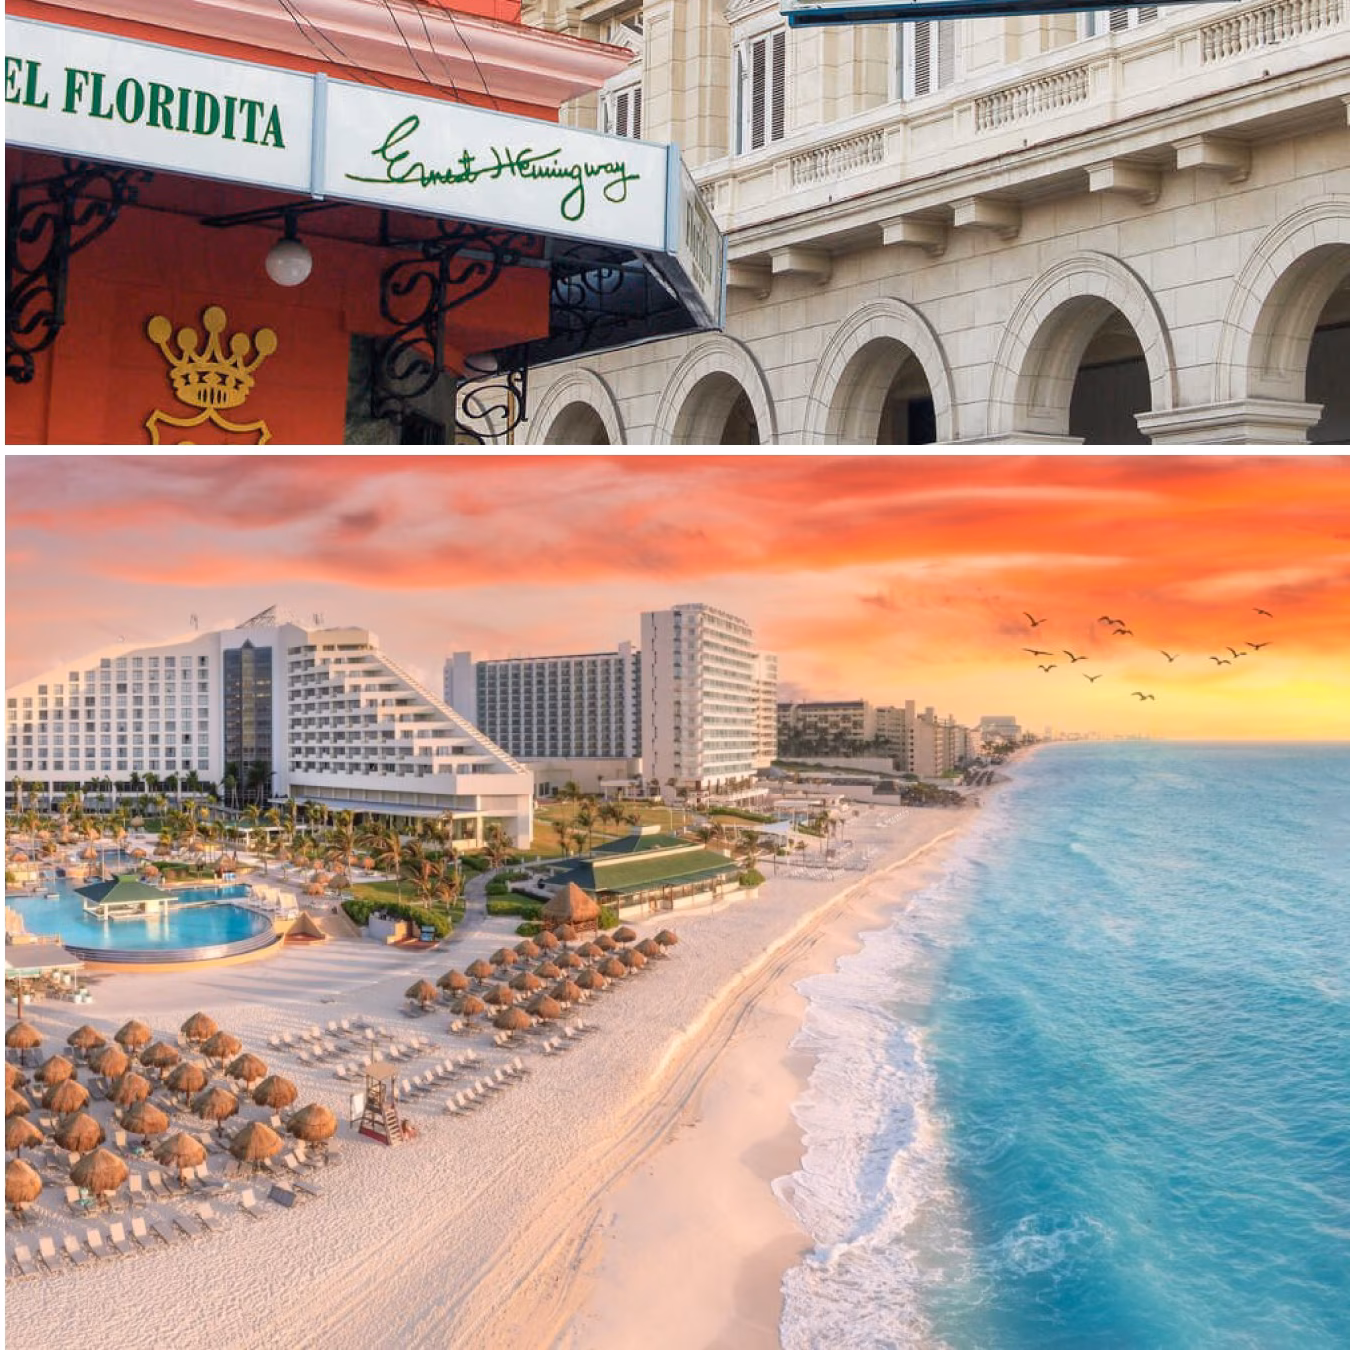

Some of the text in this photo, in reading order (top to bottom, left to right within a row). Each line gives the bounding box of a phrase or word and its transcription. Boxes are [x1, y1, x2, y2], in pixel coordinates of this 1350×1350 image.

[5, 56, 285, 149] EL FLORIDITA
[345, 115, 480, 188] Ernest
